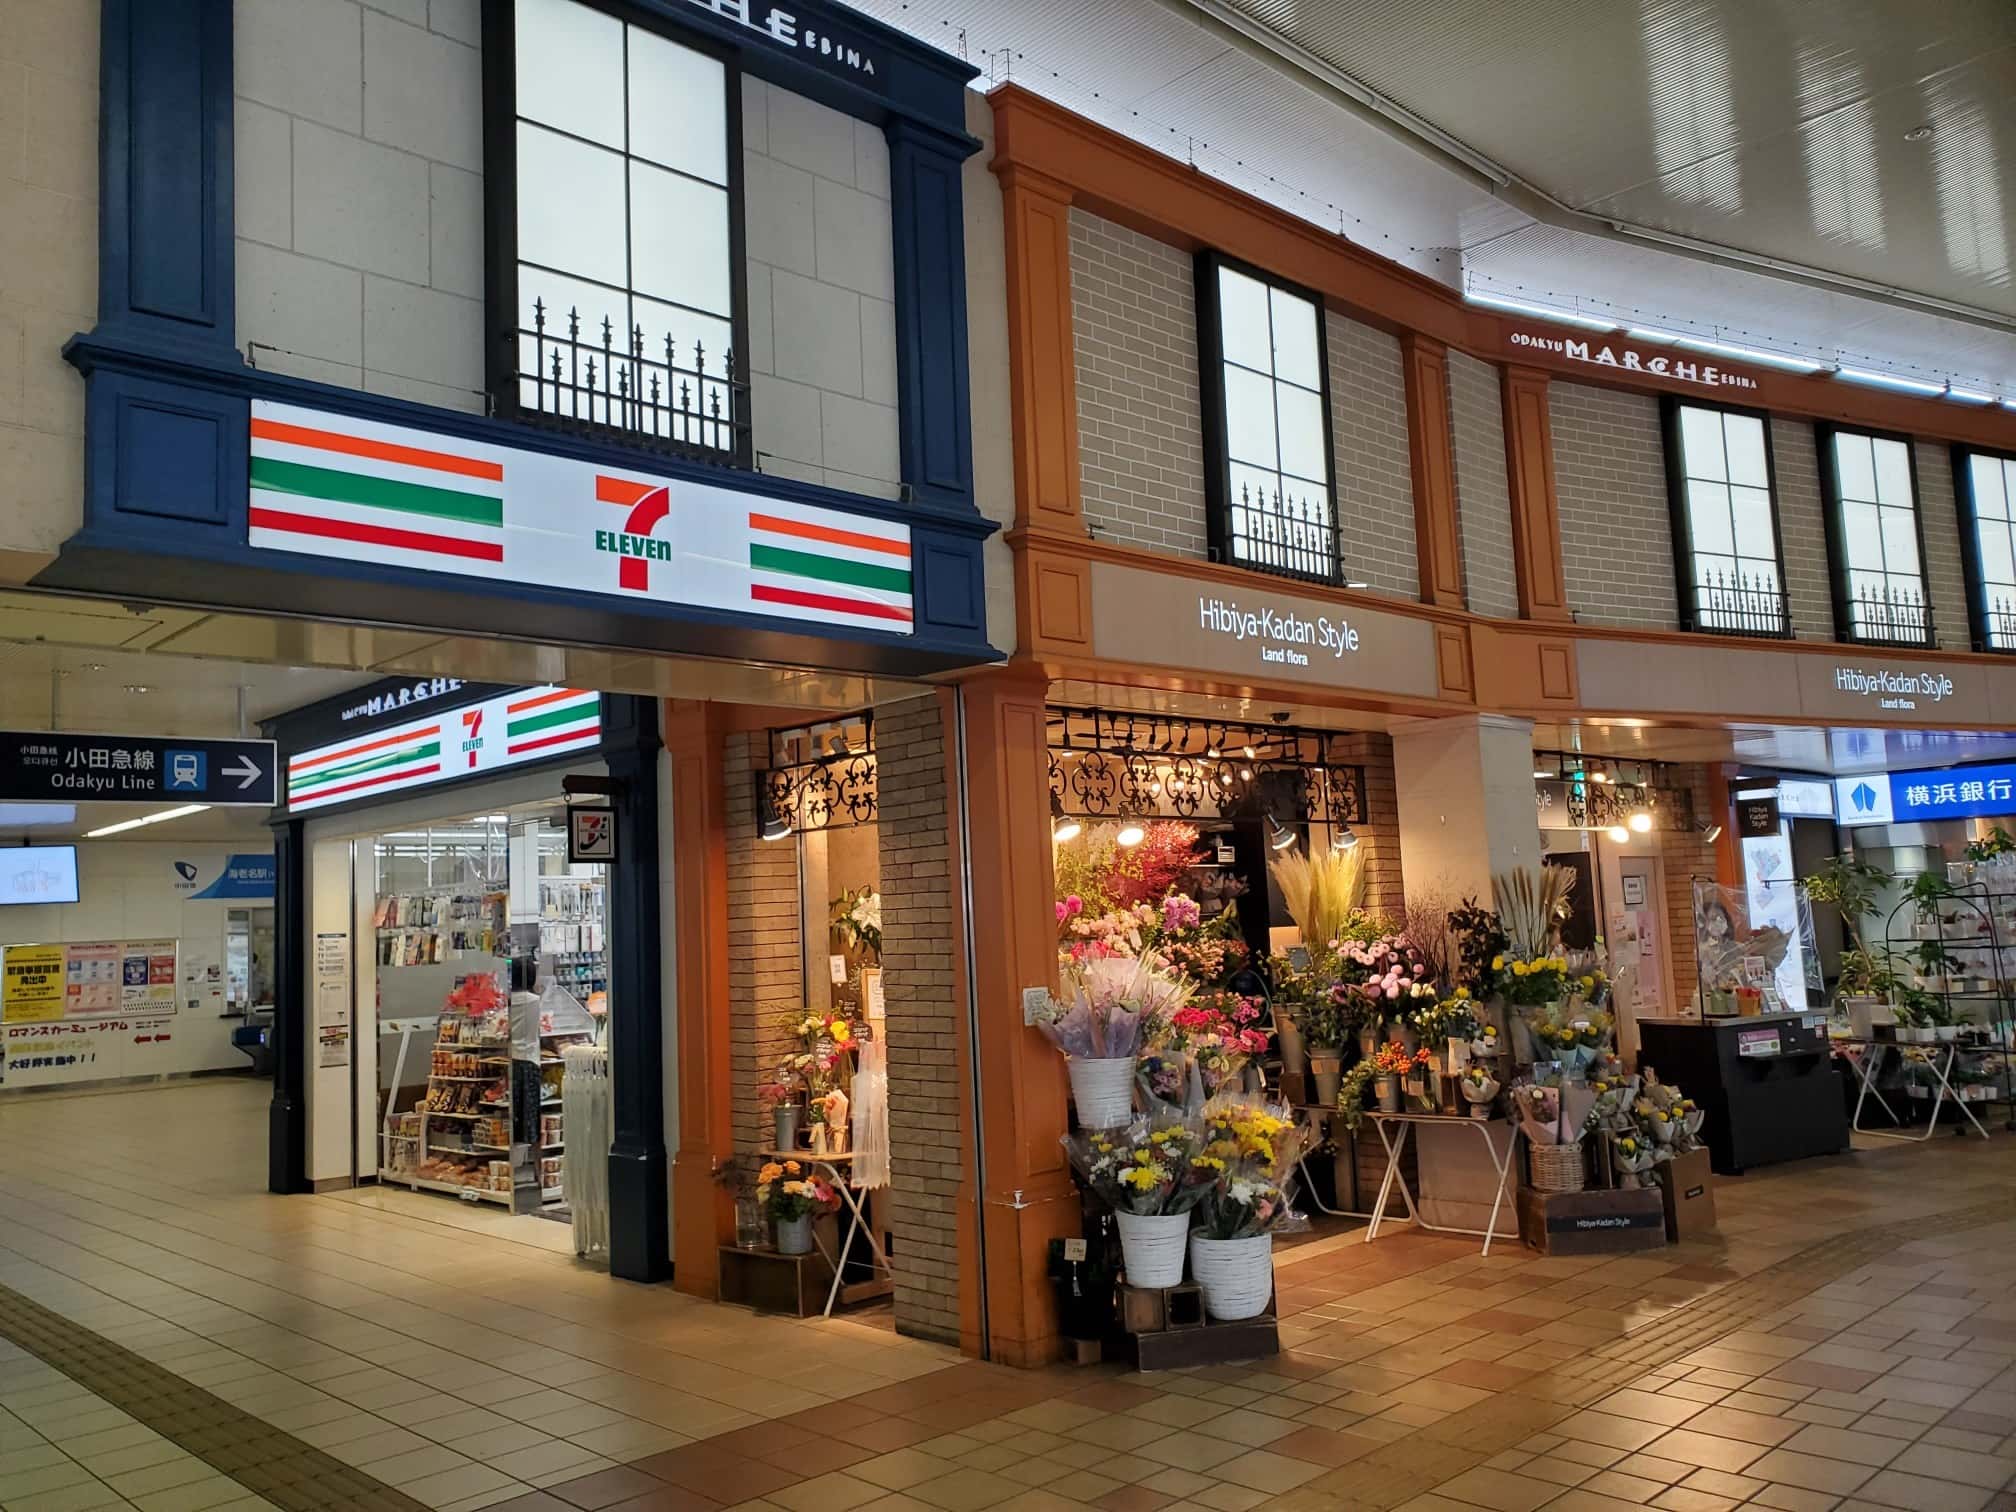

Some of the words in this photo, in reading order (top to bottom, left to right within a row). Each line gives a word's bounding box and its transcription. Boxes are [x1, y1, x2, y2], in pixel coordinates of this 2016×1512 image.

[804, 29, 875, 76] EBINA
[1510, 332, 1563, 352] ODAKYU
[1565, 338, 1720, 387] MARCHE
[1721, 373, 1757, 389] EBINA
[595, 474, 671, 592] 7
[1199, 597, 1316, 645] Hibiya-Kadan
[1317, 616, 1360, 658] Style
[1262, 646, 1285, 663] Land
[1286, 649, 1309, 666] flora
[1836, 667, 1921, 695] Hibiya-Kadan
[1920, 672, 1953, 701] Style
[1881, 697, 1898, 709] Land
[1899, 698, 1915, 710] flora
[64, 746, 156, 771] 小田急線
[51, 772, 115, 792] Odakyu
[122, 774, 156, 790] Line
[1905, 778, 2013, 807] 横浜銀行
[8, 1021, 129, 1038] ロマンスカーミュージアム
